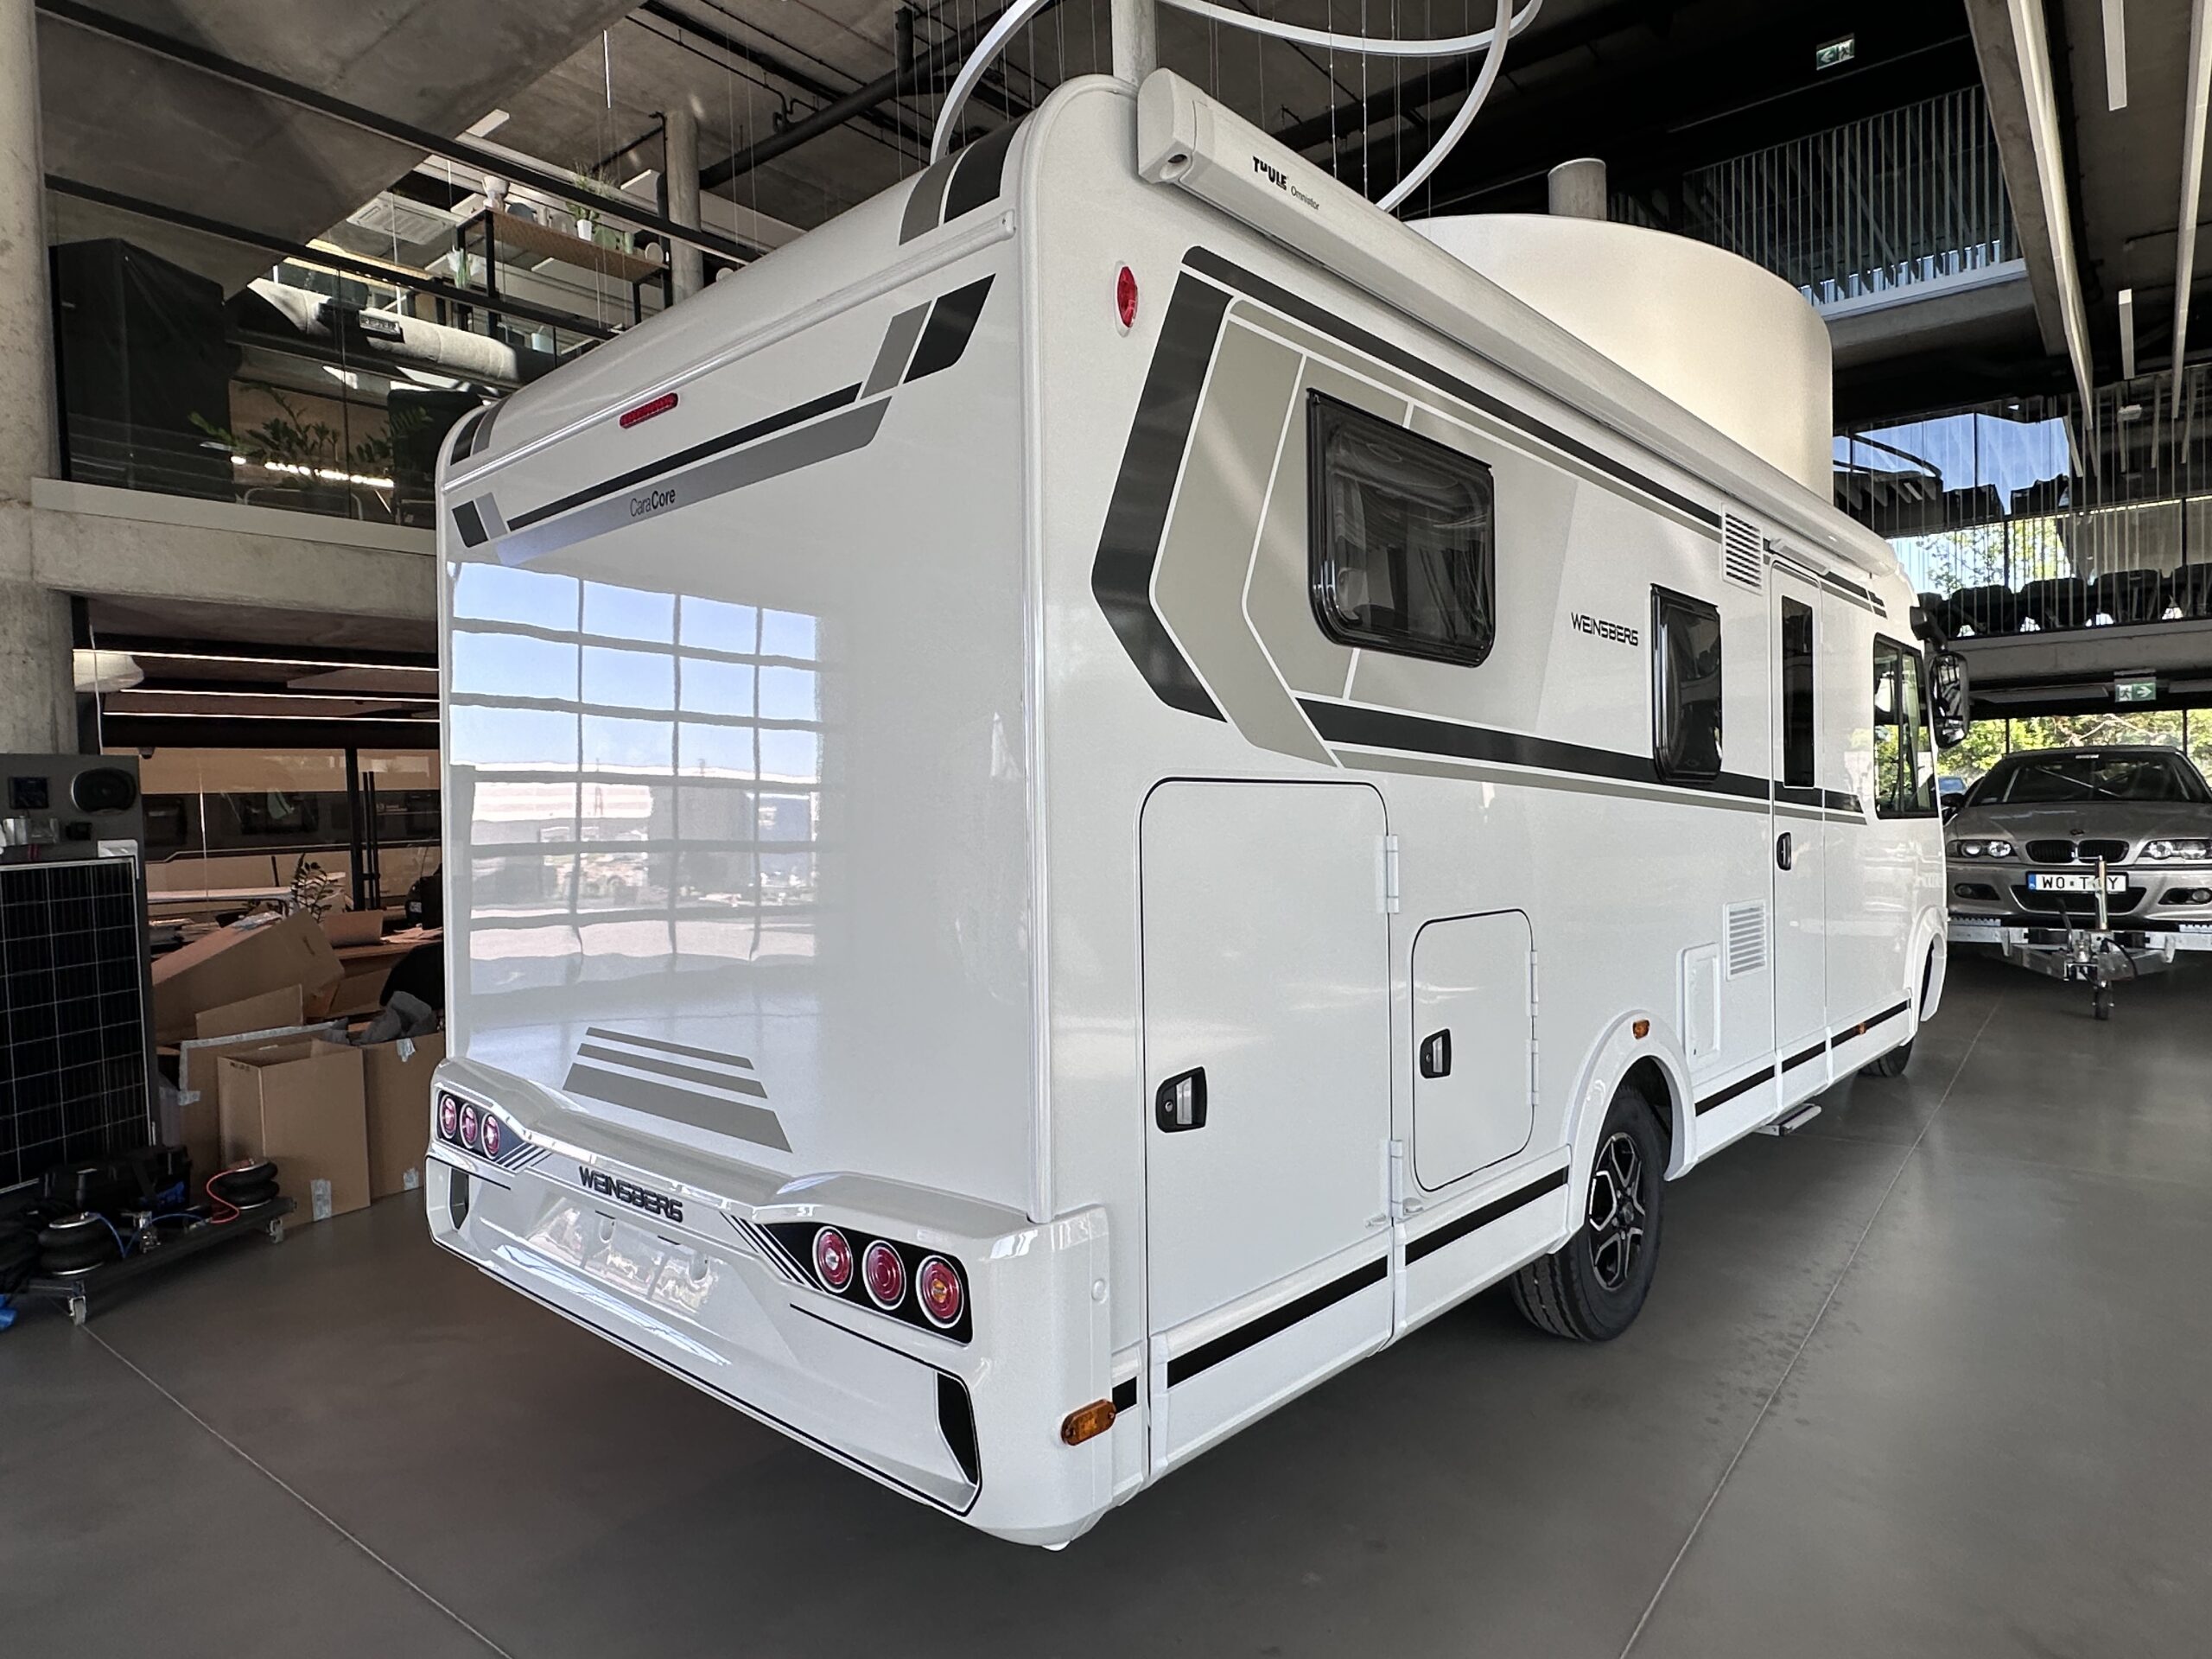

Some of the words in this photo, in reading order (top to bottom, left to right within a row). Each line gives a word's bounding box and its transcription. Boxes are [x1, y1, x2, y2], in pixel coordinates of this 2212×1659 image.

[1253, 156, 1287, 191] THULE
[630, 489, 676, 517] CaraCore
[1571, 612, 1638, 646] WEINSBERG
[2079, 876, 2119, 890] TY
[579, 1166, 683, 1223] WEINSBERG
